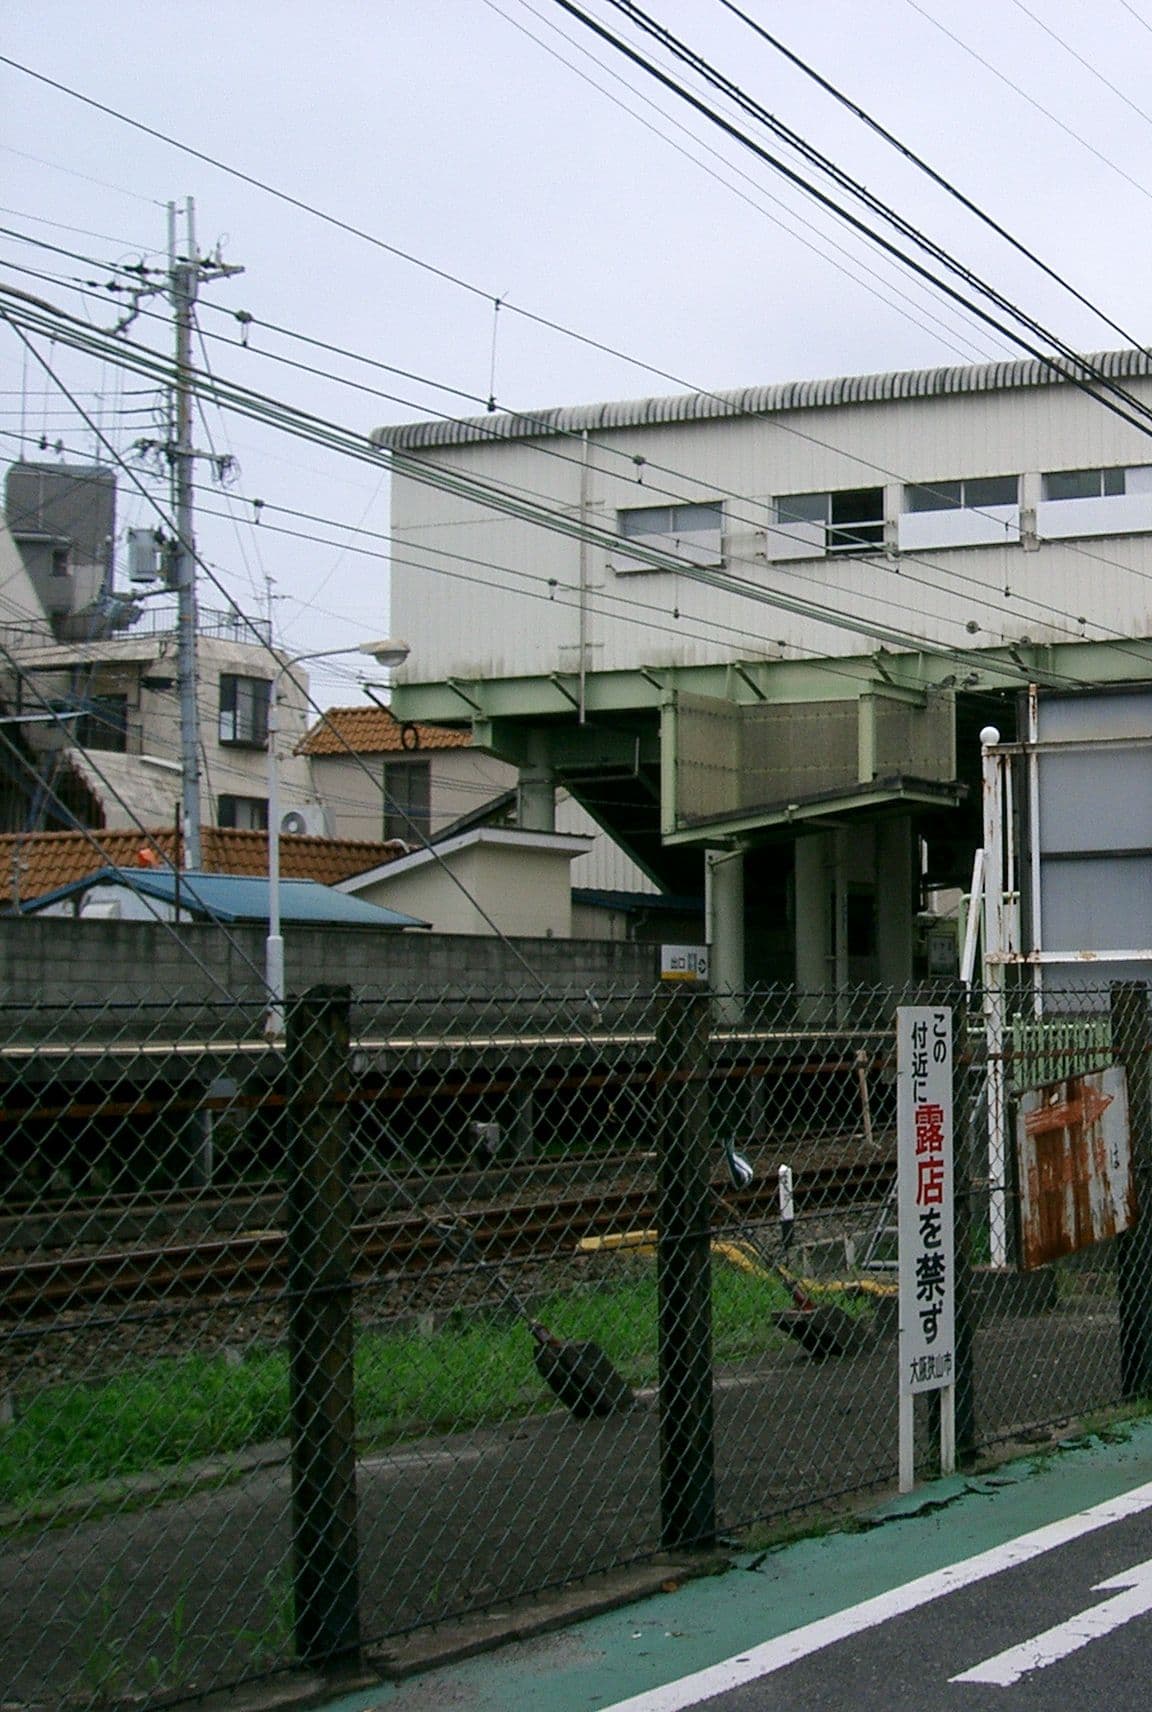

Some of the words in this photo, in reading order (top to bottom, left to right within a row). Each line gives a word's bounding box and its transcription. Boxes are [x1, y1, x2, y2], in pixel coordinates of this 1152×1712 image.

[910, 1020, 928, 1103] 付近に
[932, 1012, 947, 1064] この
